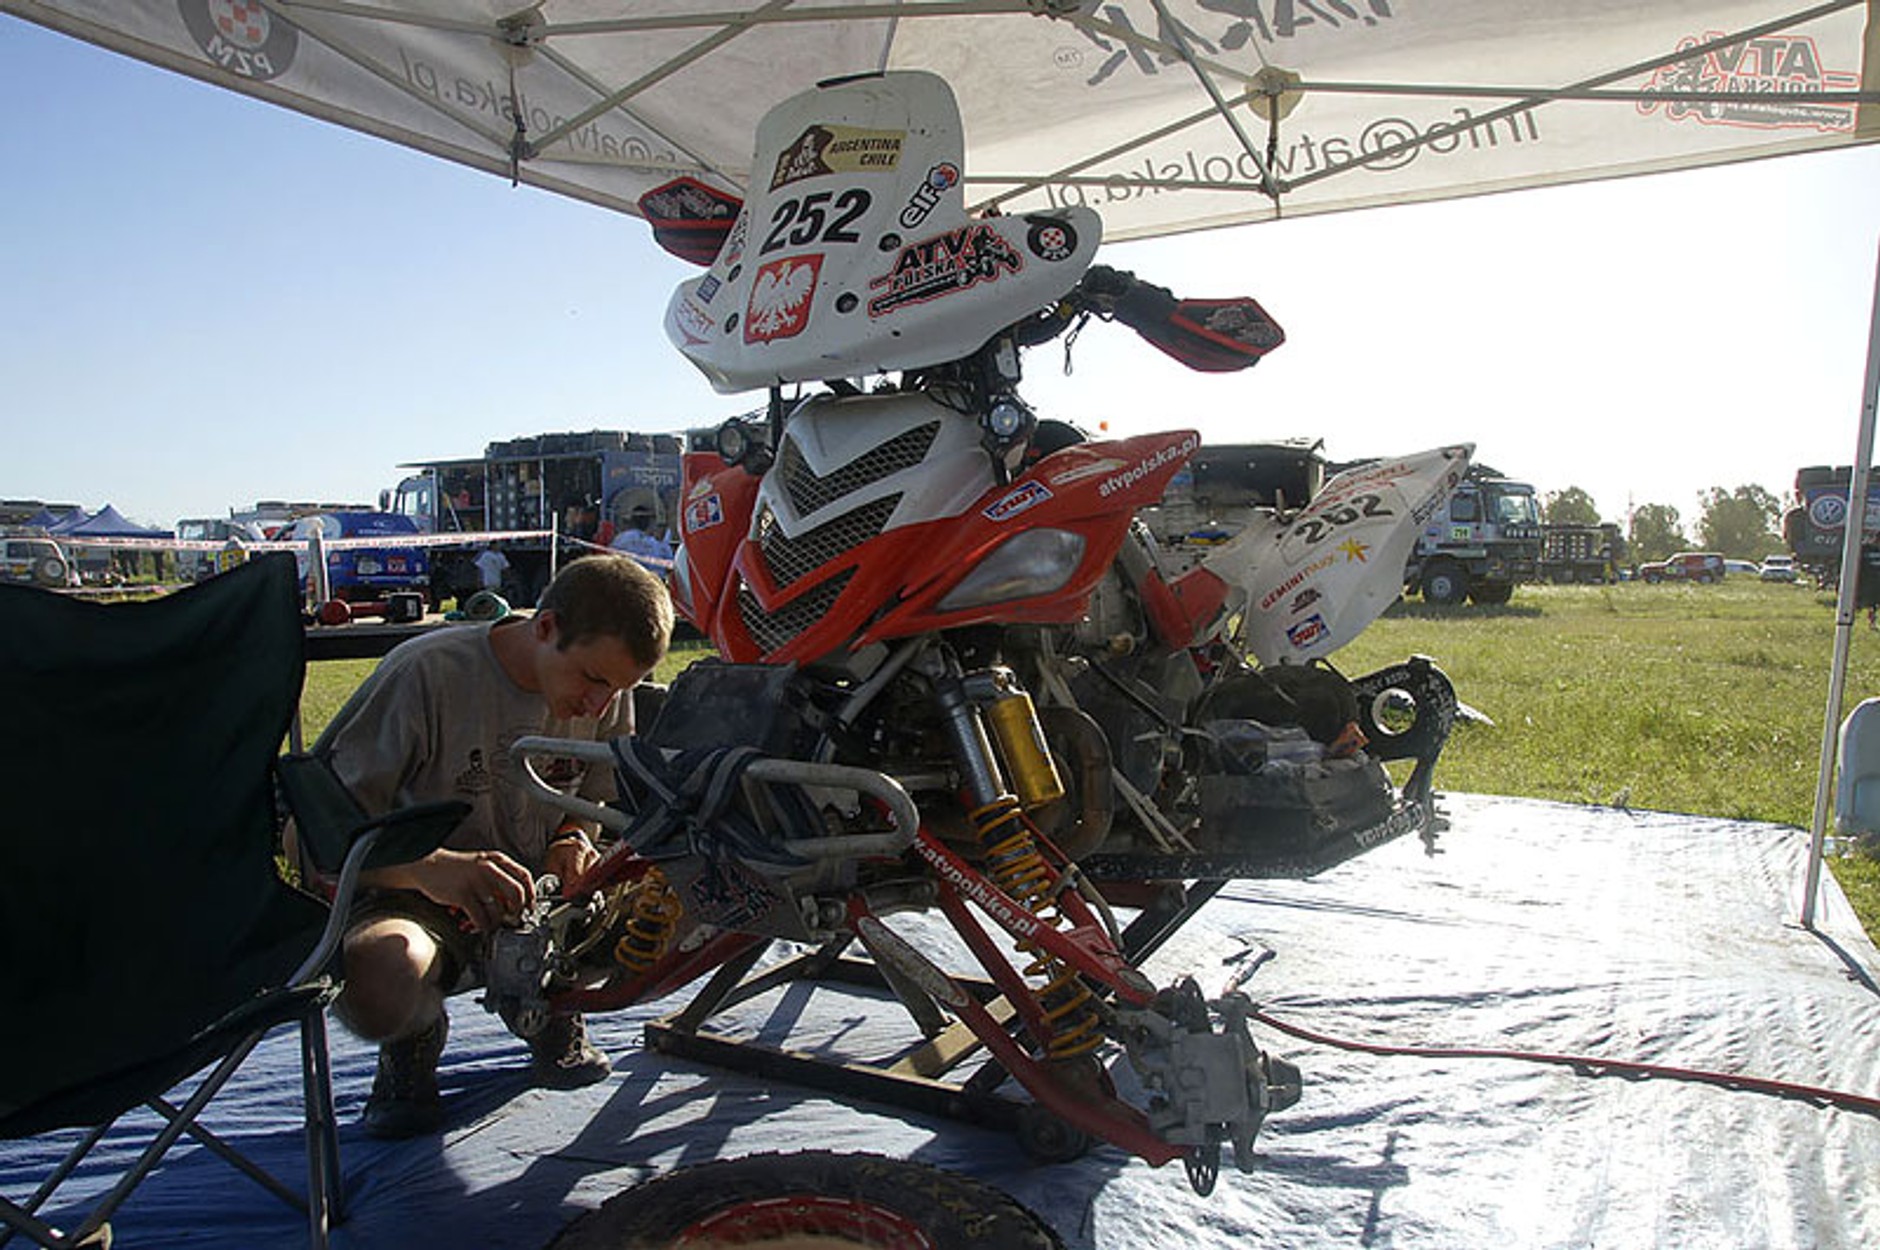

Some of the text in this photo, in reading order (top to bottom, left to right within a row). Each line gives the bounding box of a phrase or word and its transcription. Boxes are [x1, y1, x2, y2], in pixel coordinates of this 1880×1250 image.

[830, 137, 901, 154] ARGENTINA
[860, 152, 896, 166] CHILE
[760, 188, 872, 256] 252
[893, 257, 959, 291] POLSKA
[895, 228, 966, 275] ATV
[1099, 433, 1199, 497] atvpolska.pl
[1294, 493, 1394, 544] 252
